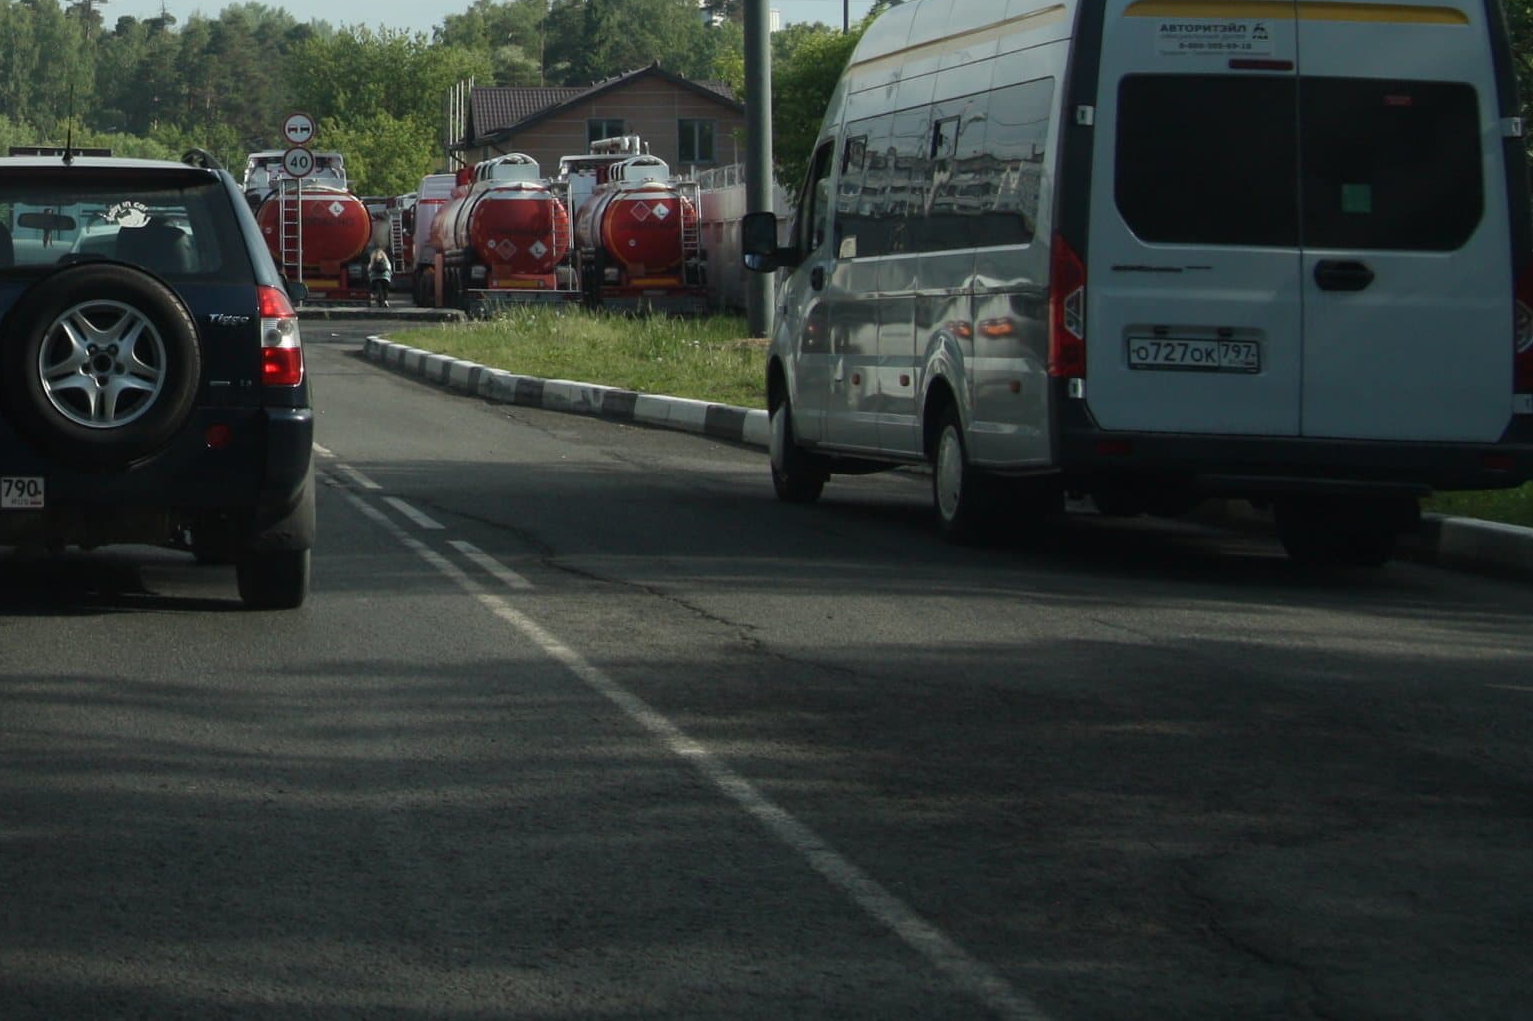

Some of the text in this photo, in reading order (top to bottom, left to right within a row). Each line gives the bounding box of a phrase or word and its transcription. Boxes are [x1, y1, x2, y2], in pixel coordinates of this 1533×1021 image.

[1160, 23, 1246, 33] АВТОРИТЭЙЛ
[290, 156, 308, 168] 40
[1221, 344, 1253, 360] 797
[3, 479, 38, 497] 790
